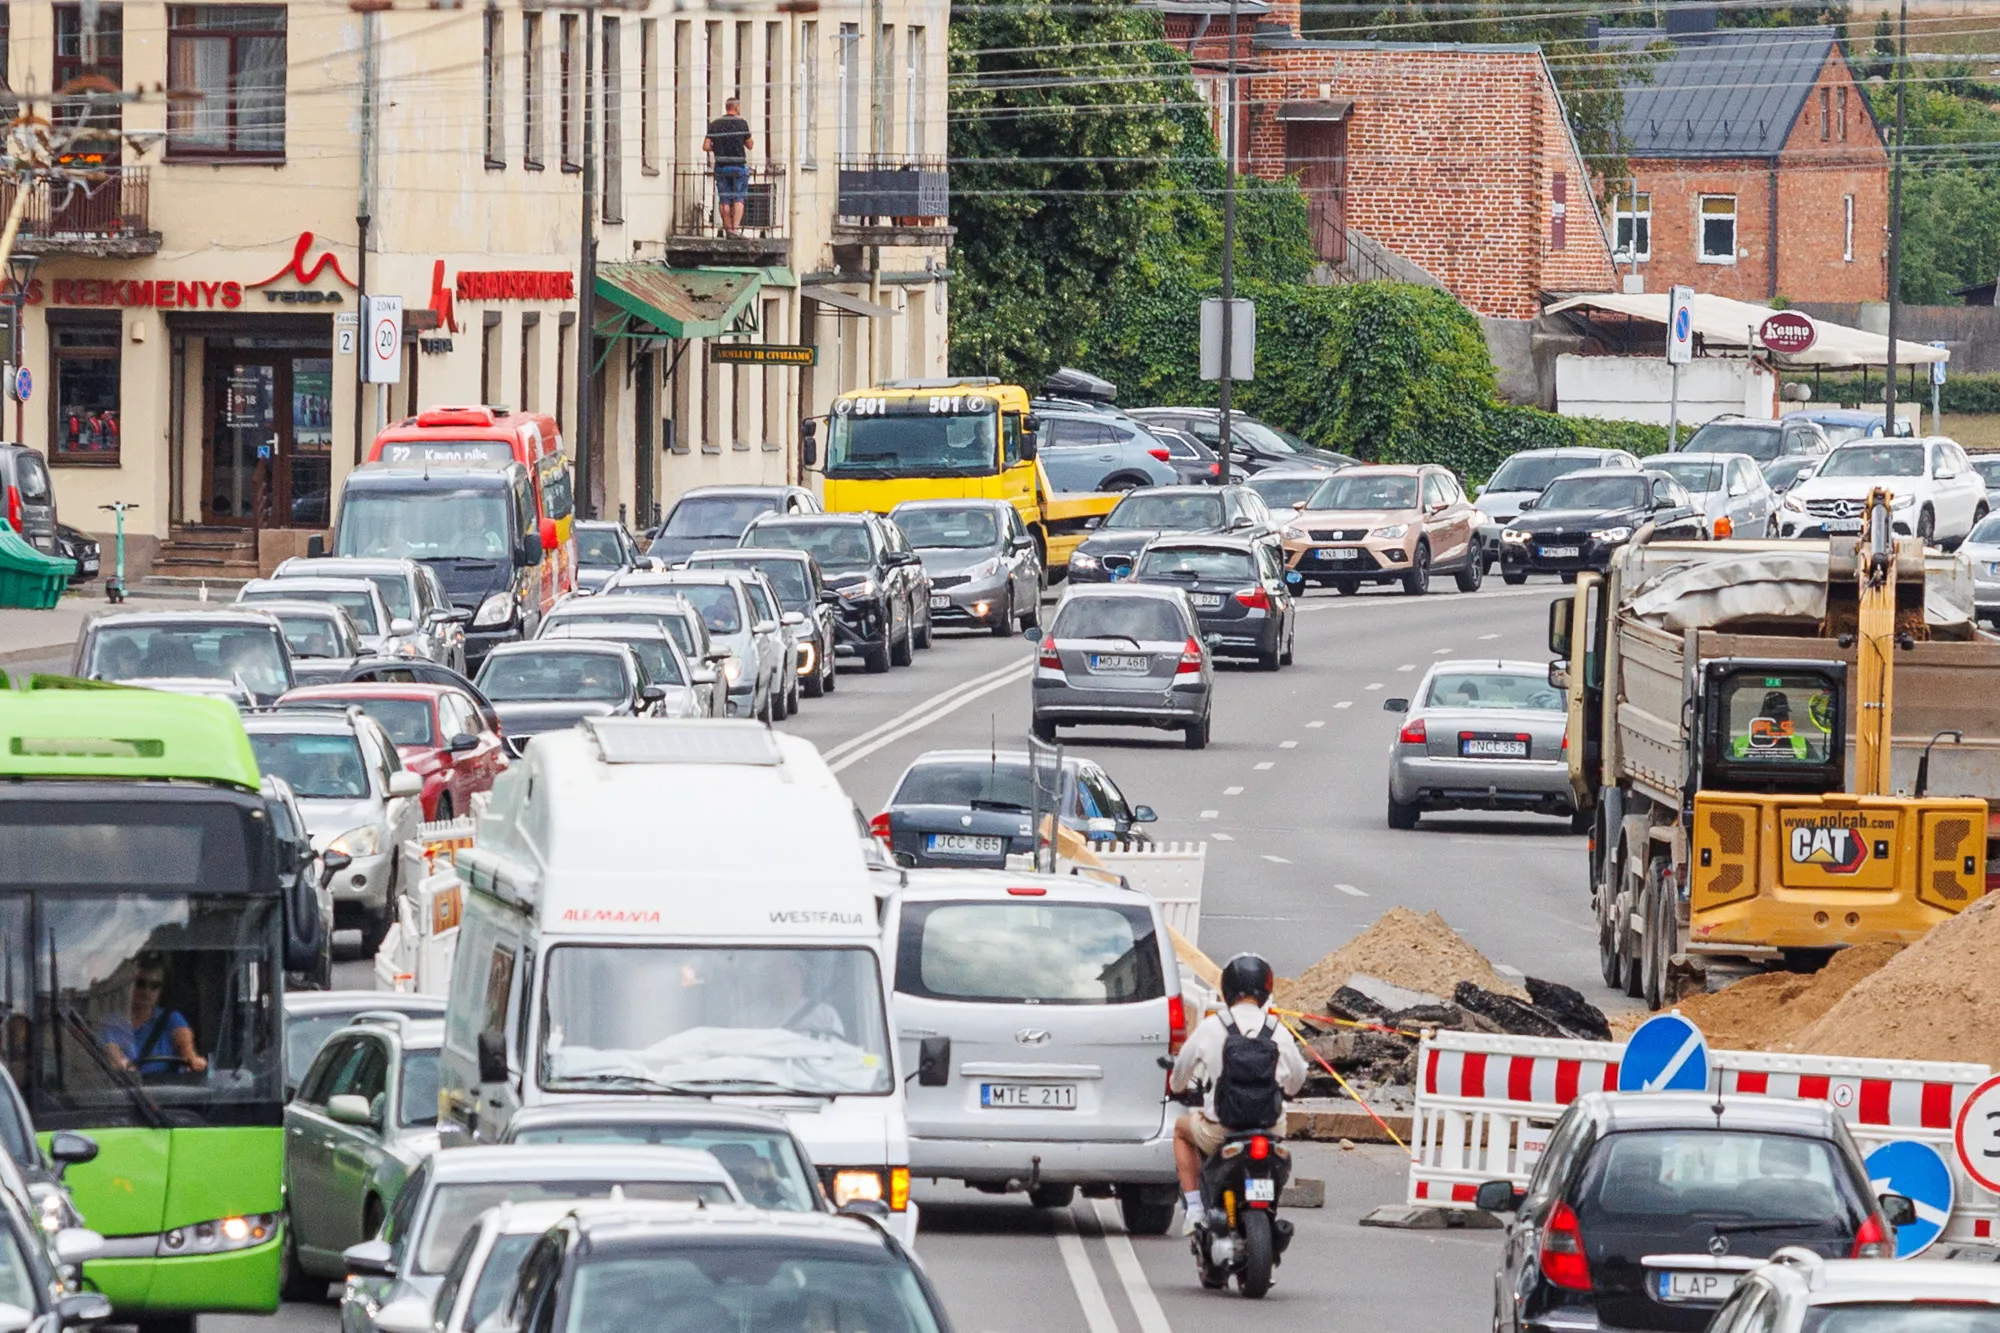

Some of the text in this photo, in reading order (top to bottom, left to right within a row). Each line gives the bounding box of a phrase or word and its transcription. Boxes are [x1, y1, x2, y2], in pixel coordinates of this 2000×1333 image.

[52, 278, 242, 308] REIKMENYS
[263, 290, 344, 303] TEIDA
[376, 301, 396, 311] ZONA
[381, 330, 393, 347] 20
[1764, 321, 1810, 340] Kauno
[342, 333, 350, 350] 2
[754, 351, 764, 360] IR
[234, 395, 256, 405] 9-18
[855, 398, 886, 415] 501
[928, 396, 960, 412] 501
[1100, 655, 1120, 668] MOJ
[1127, 656, 1146, 668] 466
[1477, 742, 1524, 753] NCC 352
[937, 835, 965, 849] JCC
[1791, 827, 1850, 863] CAT
[769, 911, 863, 924] WESTFALIA
[993, 1087, 1072, 1105] MTE 211
[1673, 1276, 1718, 1295] LAP
